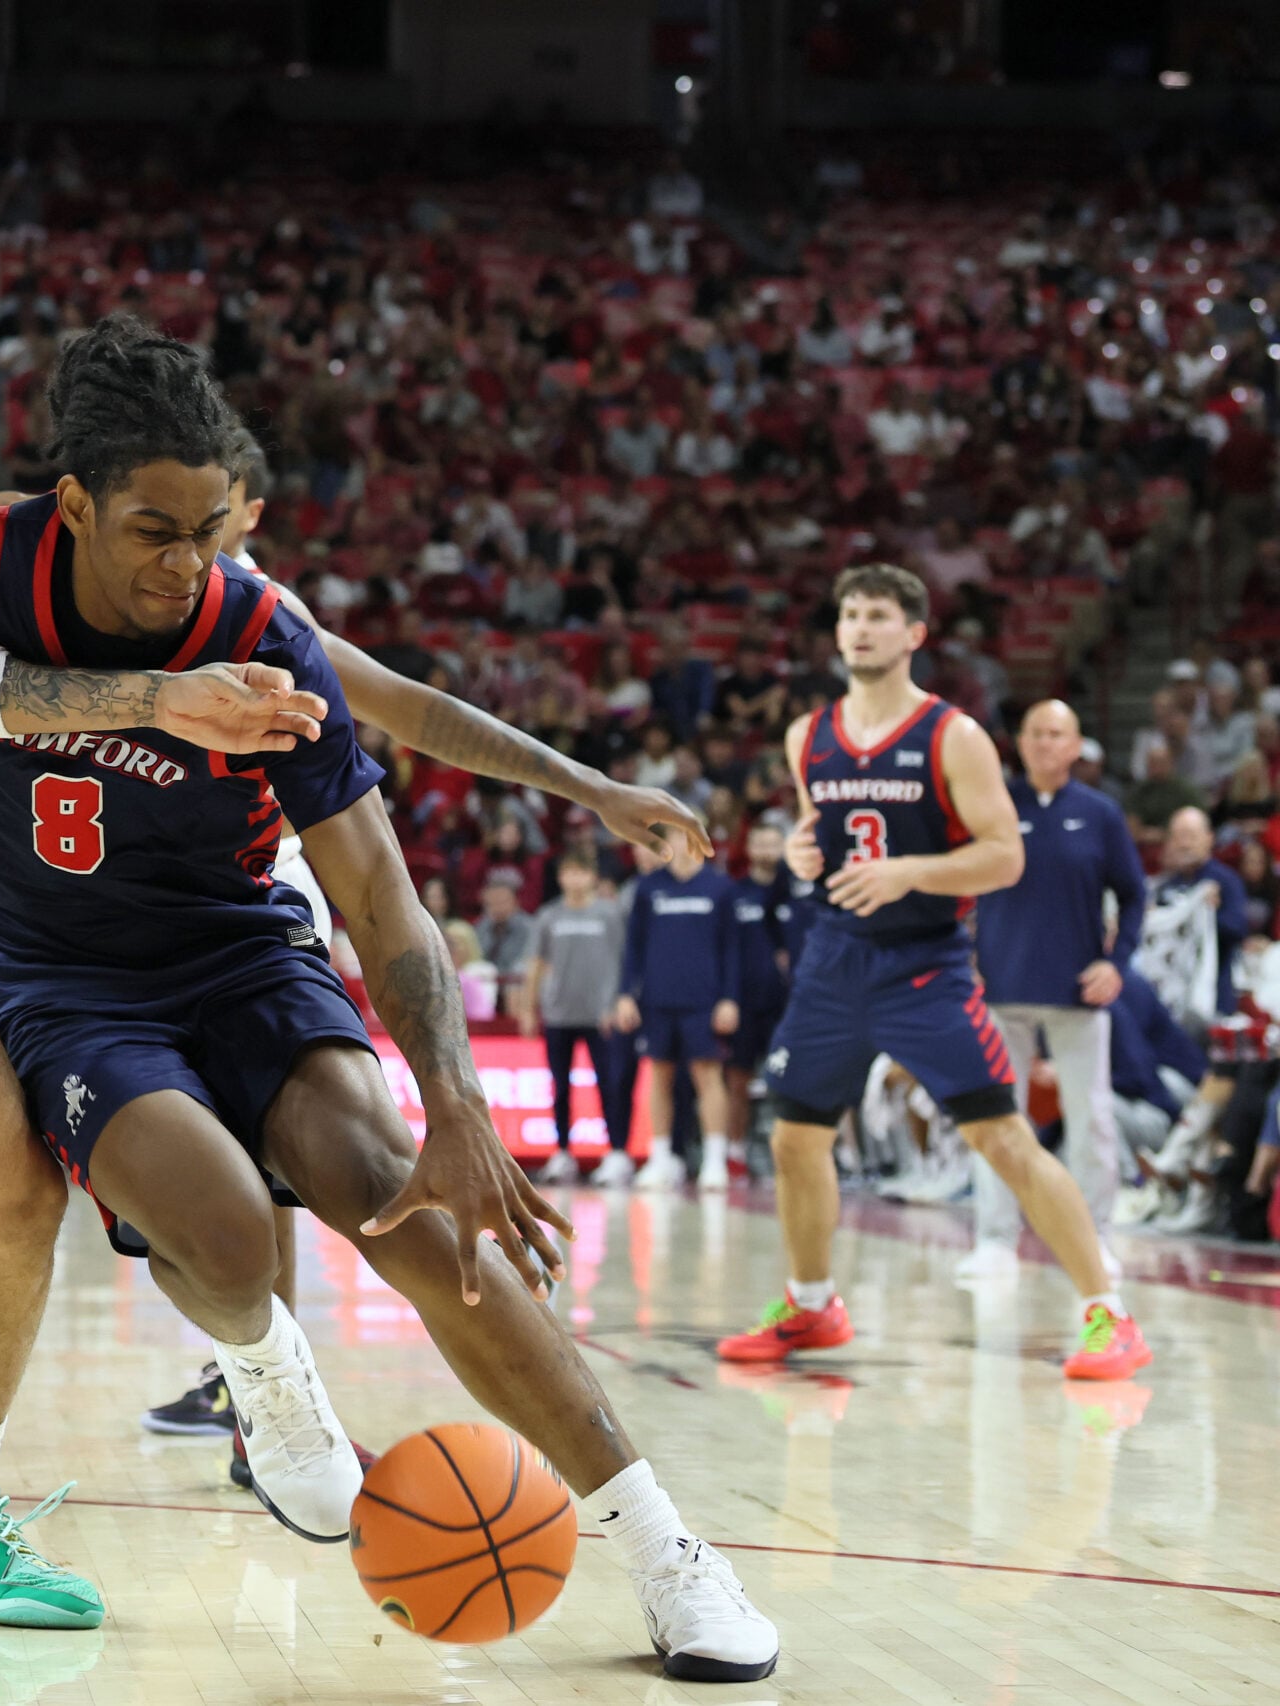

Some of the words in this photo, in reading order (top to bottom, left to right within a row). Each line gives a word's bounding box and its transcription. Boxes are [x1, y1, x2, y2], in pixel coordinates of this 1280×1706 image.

[810, 778, 924, 803] SAMFORD
[31, 772, 105, 875] 8
[843, 808, 888, 863] 3
